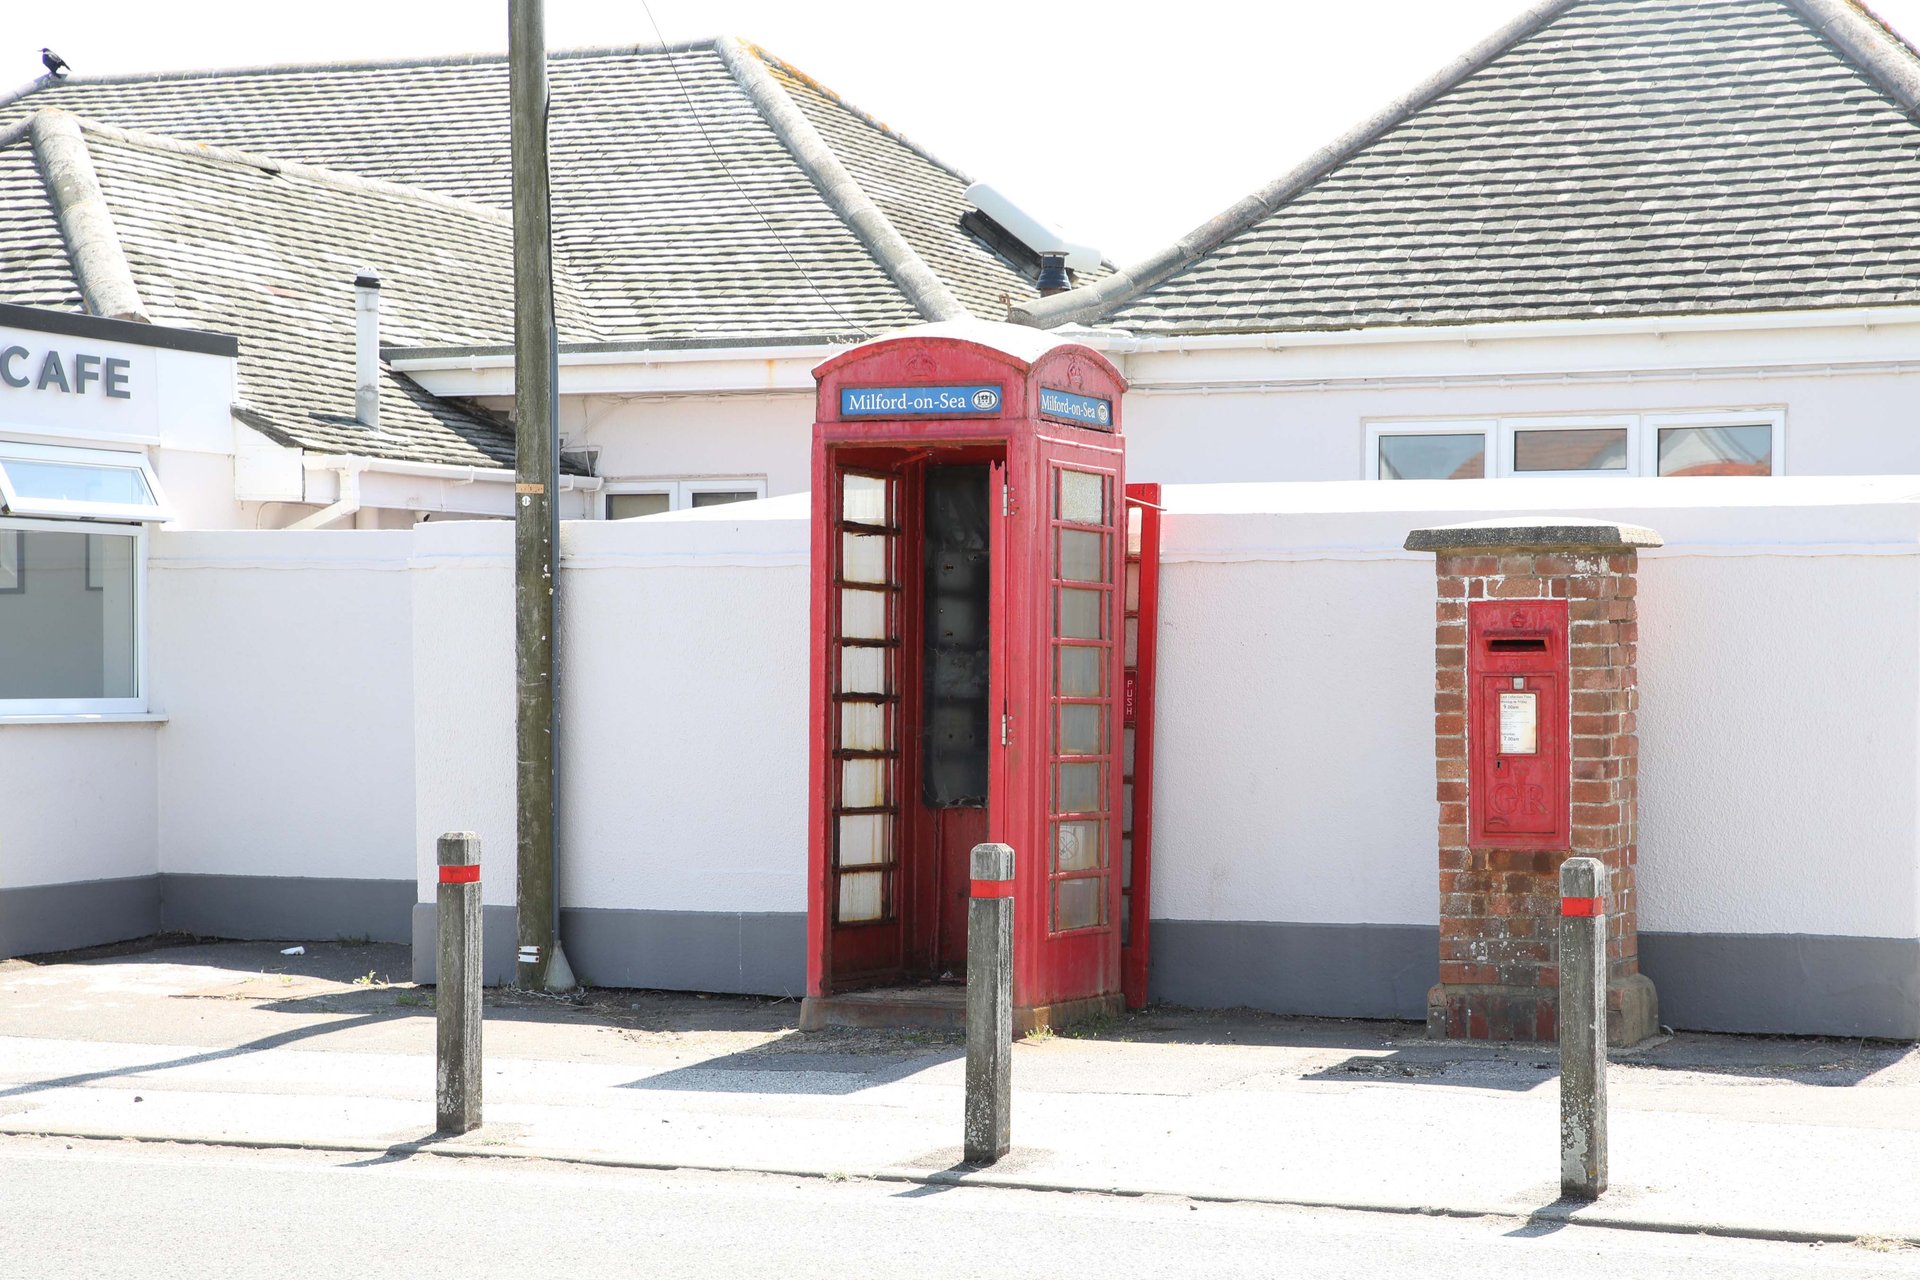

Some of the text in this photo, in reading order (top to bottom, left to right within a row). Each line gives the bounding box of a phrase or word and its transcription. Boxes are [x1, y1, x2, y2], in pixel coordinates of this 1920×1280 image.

[0, 345, 131, 399] CAFE
[849, 392, 967, 410] Milford-on-Sea
[1041, 394, 1096, 419] Milford-on-Sea
